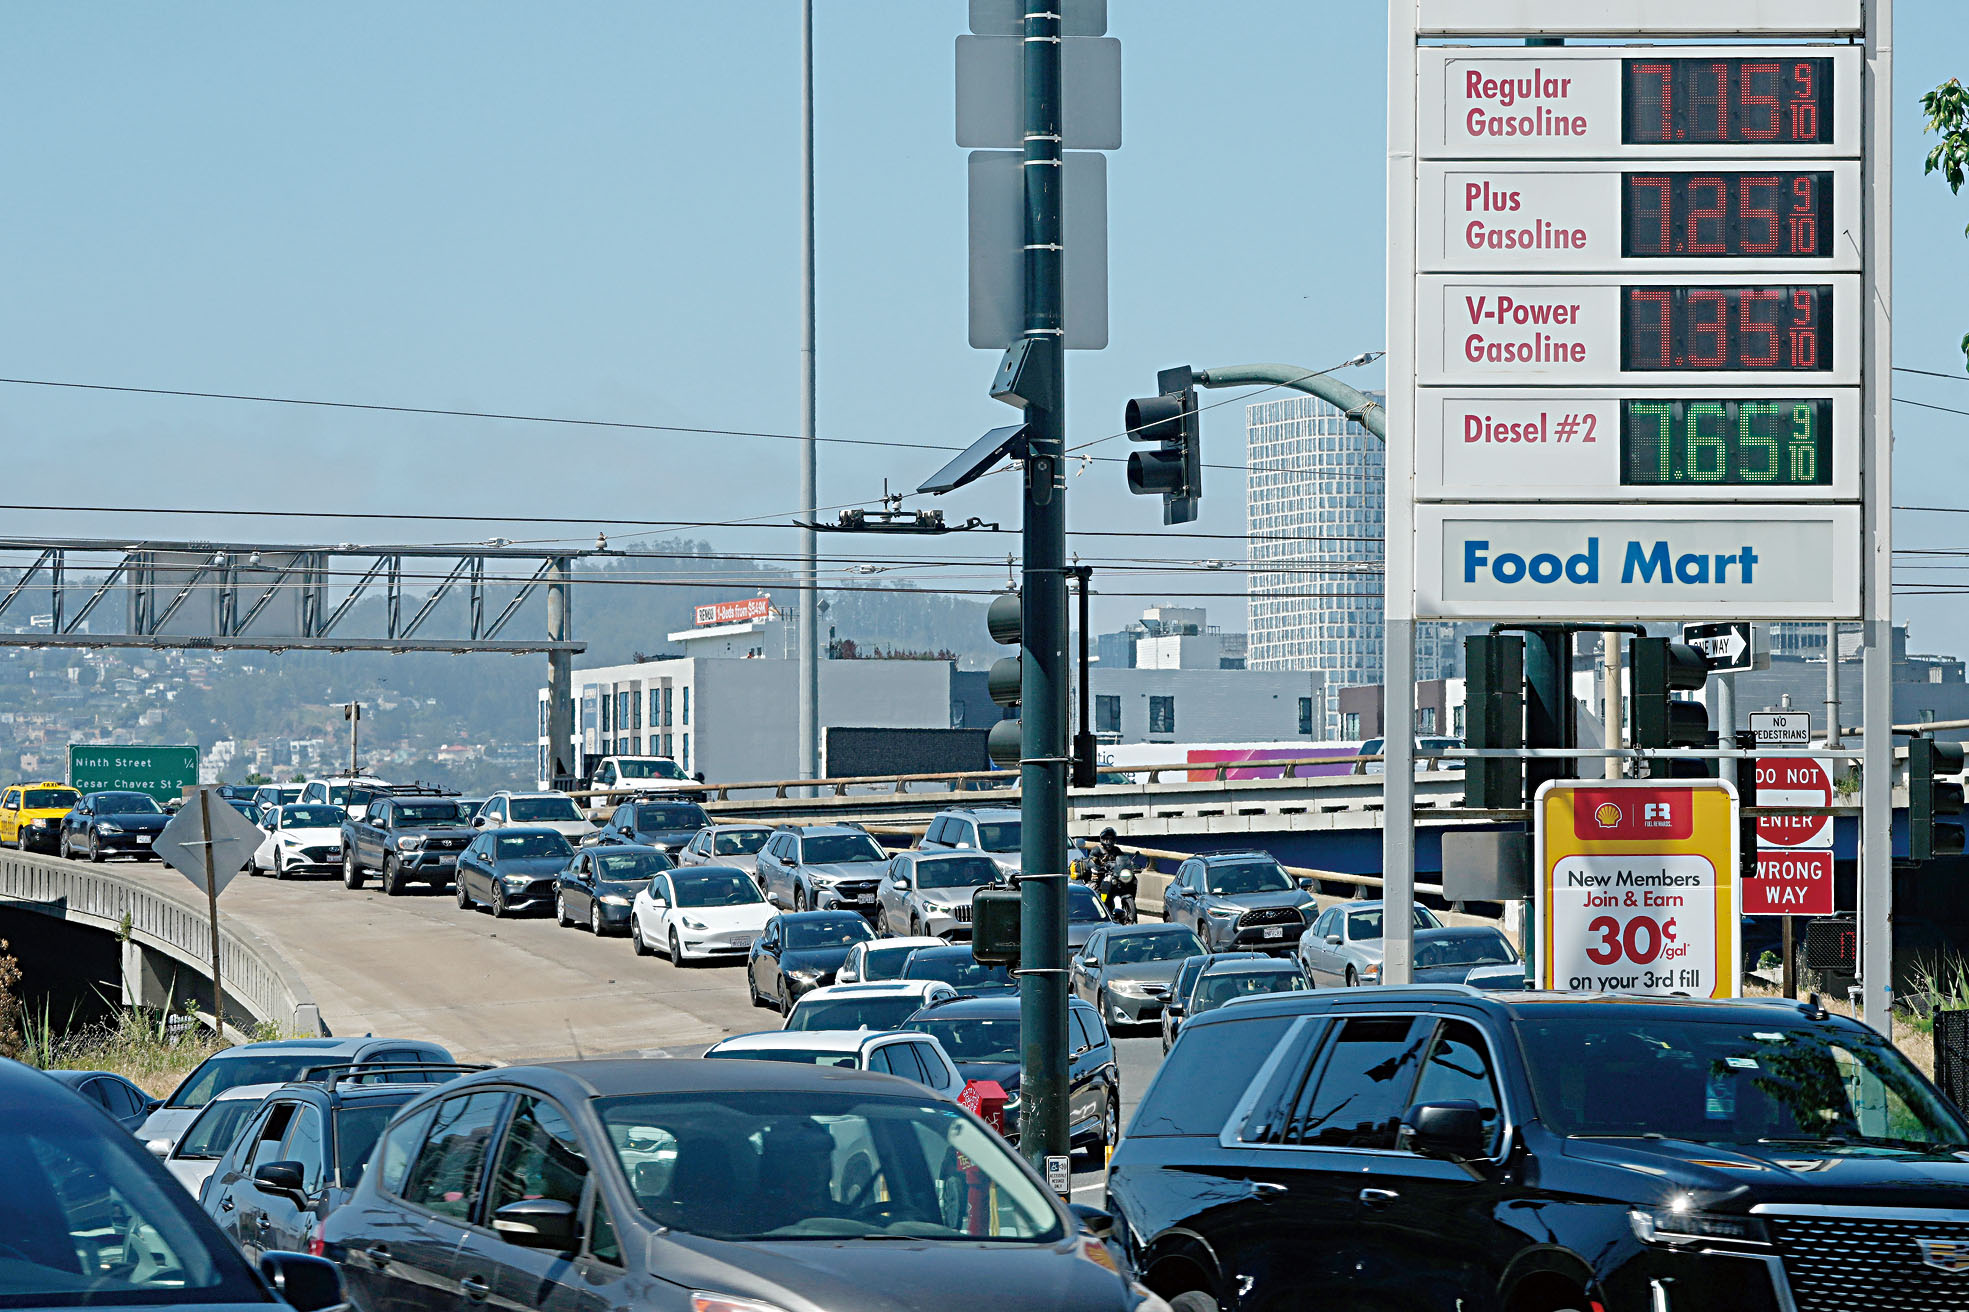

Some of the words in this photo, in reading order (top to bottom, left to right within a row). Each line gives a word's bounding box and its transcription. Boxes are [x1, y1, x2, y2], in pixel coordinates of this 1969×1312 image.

[1466, 68, 1572, 107] Regular
[1632, 64, 1781, 139] 7.15
[1466, 106, 1588, 137] Gasoline
[1465, 181, 1521, 212] Plus
[1632, 177, 1779, 253] 7.25
[1465, 218, 1587, 250] Gasoline
[1465, 295, 1581, 325] V-Power
[1631, 291, 1779, 367] 7.35
[1464, 332, 1586, 363] Gasoline
[1464, 412, 1547, 443] Diesel
[1554, 413, 1597, 443] #2
[1631, 404, 1778, 481] 7.65
[1464, 536, 1599, 584] Food
[1621, 541, 1759, 585] Mart
[1712, 638, 1730, 655] WAY
[1754, 730, 1807, 740] PEDESTRIANS
[1773, 717, 1787, 727] NO
[75, 758, 109, 768] Ninth
[115, 758, 152, 768] Street
[75, 779, 109, 788] Cesar
[114, 780, 155, 789] Chavez
[160, 780, 172, 789] St
[176, 780, 183, 789] 2
[1756, 769, 1776, 784] DO
[1787, 769, 1819, 784] NOT
[1760, 815, 1813, 828] ENTER
[1568, 870, 1611, 887] New
[1616, 869, 1701, 887] Members
[1754, 861, 1822, 880] WRONG
[1583, 891, 1619, 908] Join
[1623, 891, 1639, 907] &
[1644, 891, 1684, 907] Earn
[1766, 886, 1808, 904] WAY
[1569, 976, 1592, 990] on
[1597, 976, 1638, 991] your
[1644, 970, 1674, 988] 3rd
[1679, 969, 1700, 987] fill
